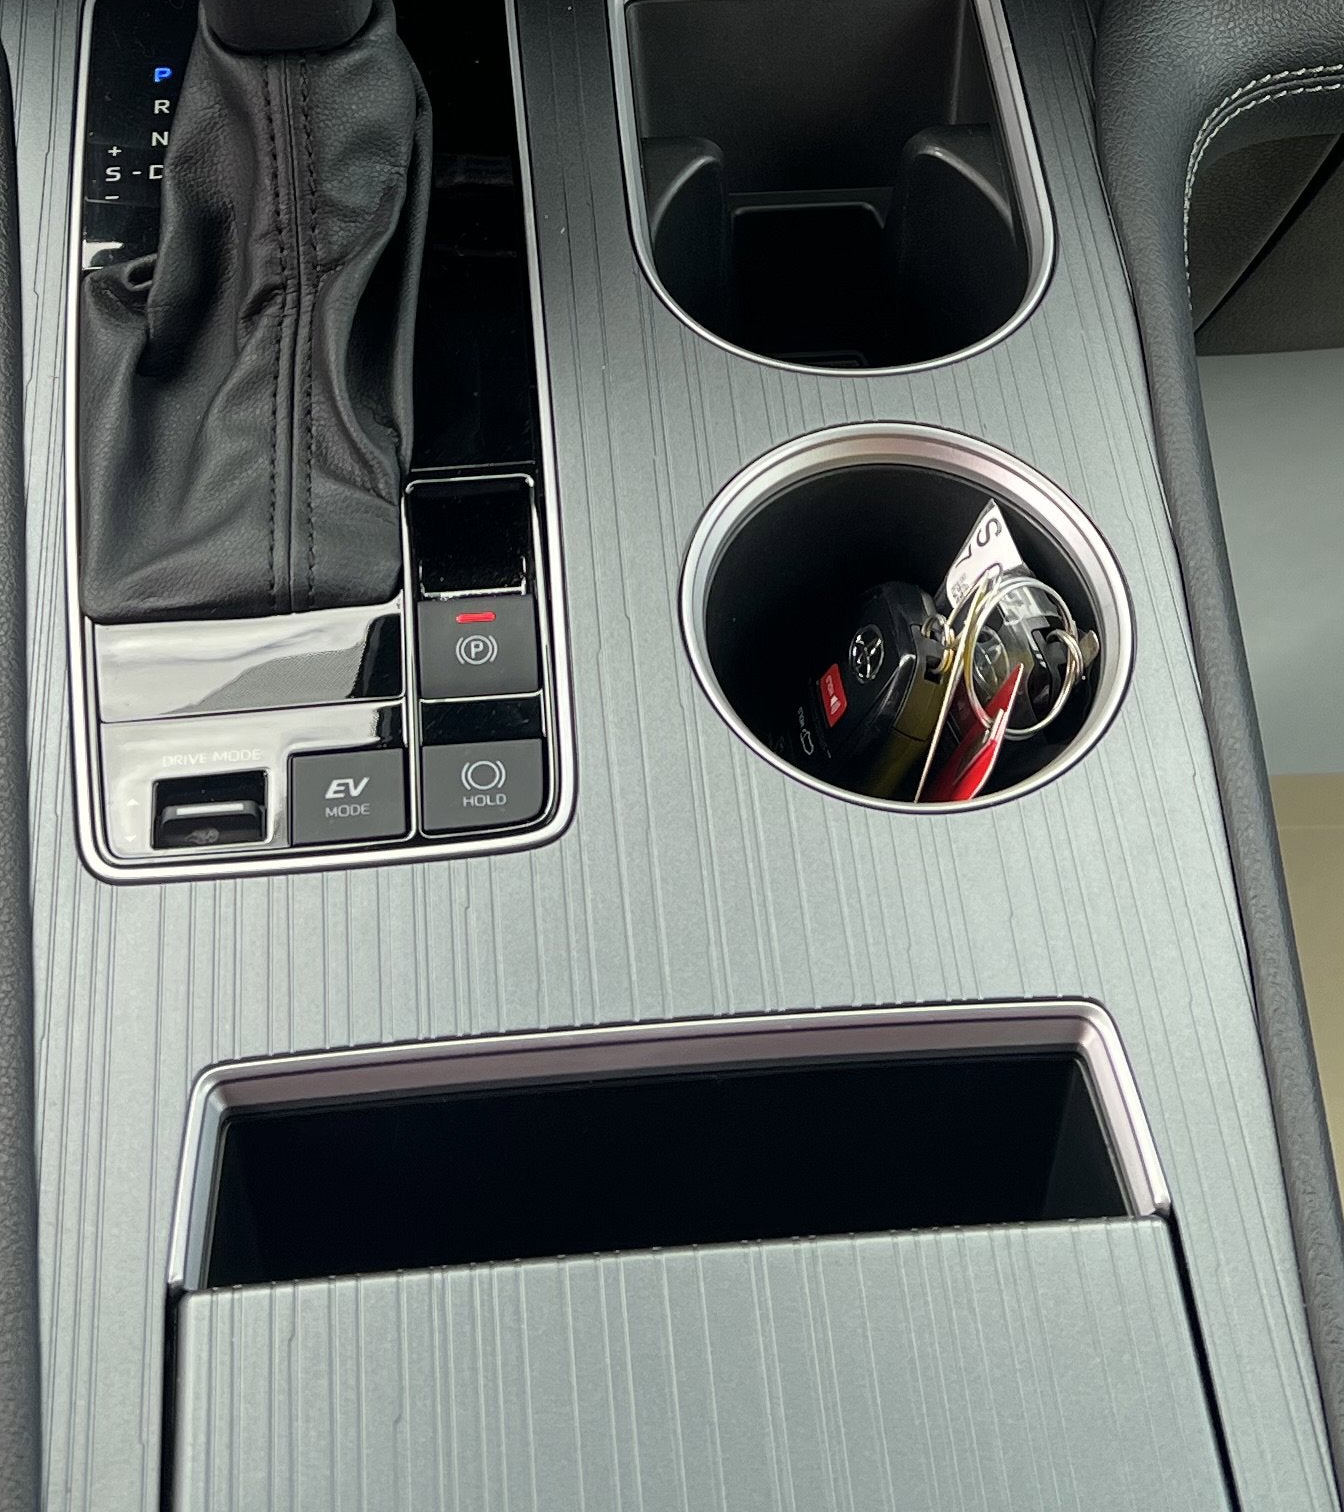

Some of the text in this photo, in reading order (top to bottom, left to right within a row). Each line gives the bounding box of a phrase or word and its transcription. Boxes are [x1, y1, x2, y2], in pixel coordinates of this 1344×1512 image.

[154, 67, 172, 82] P
[155, 100, 170, 114] R
[151, 132, 169, 146] N
[105, 167, 121, 182] S
[162, 749, 261, 767] DRIVE MODE
[325, 777, 369, 799] EV
[463, 793, 507, 806] HOLD
[325, 804, 370, 817] MODE
